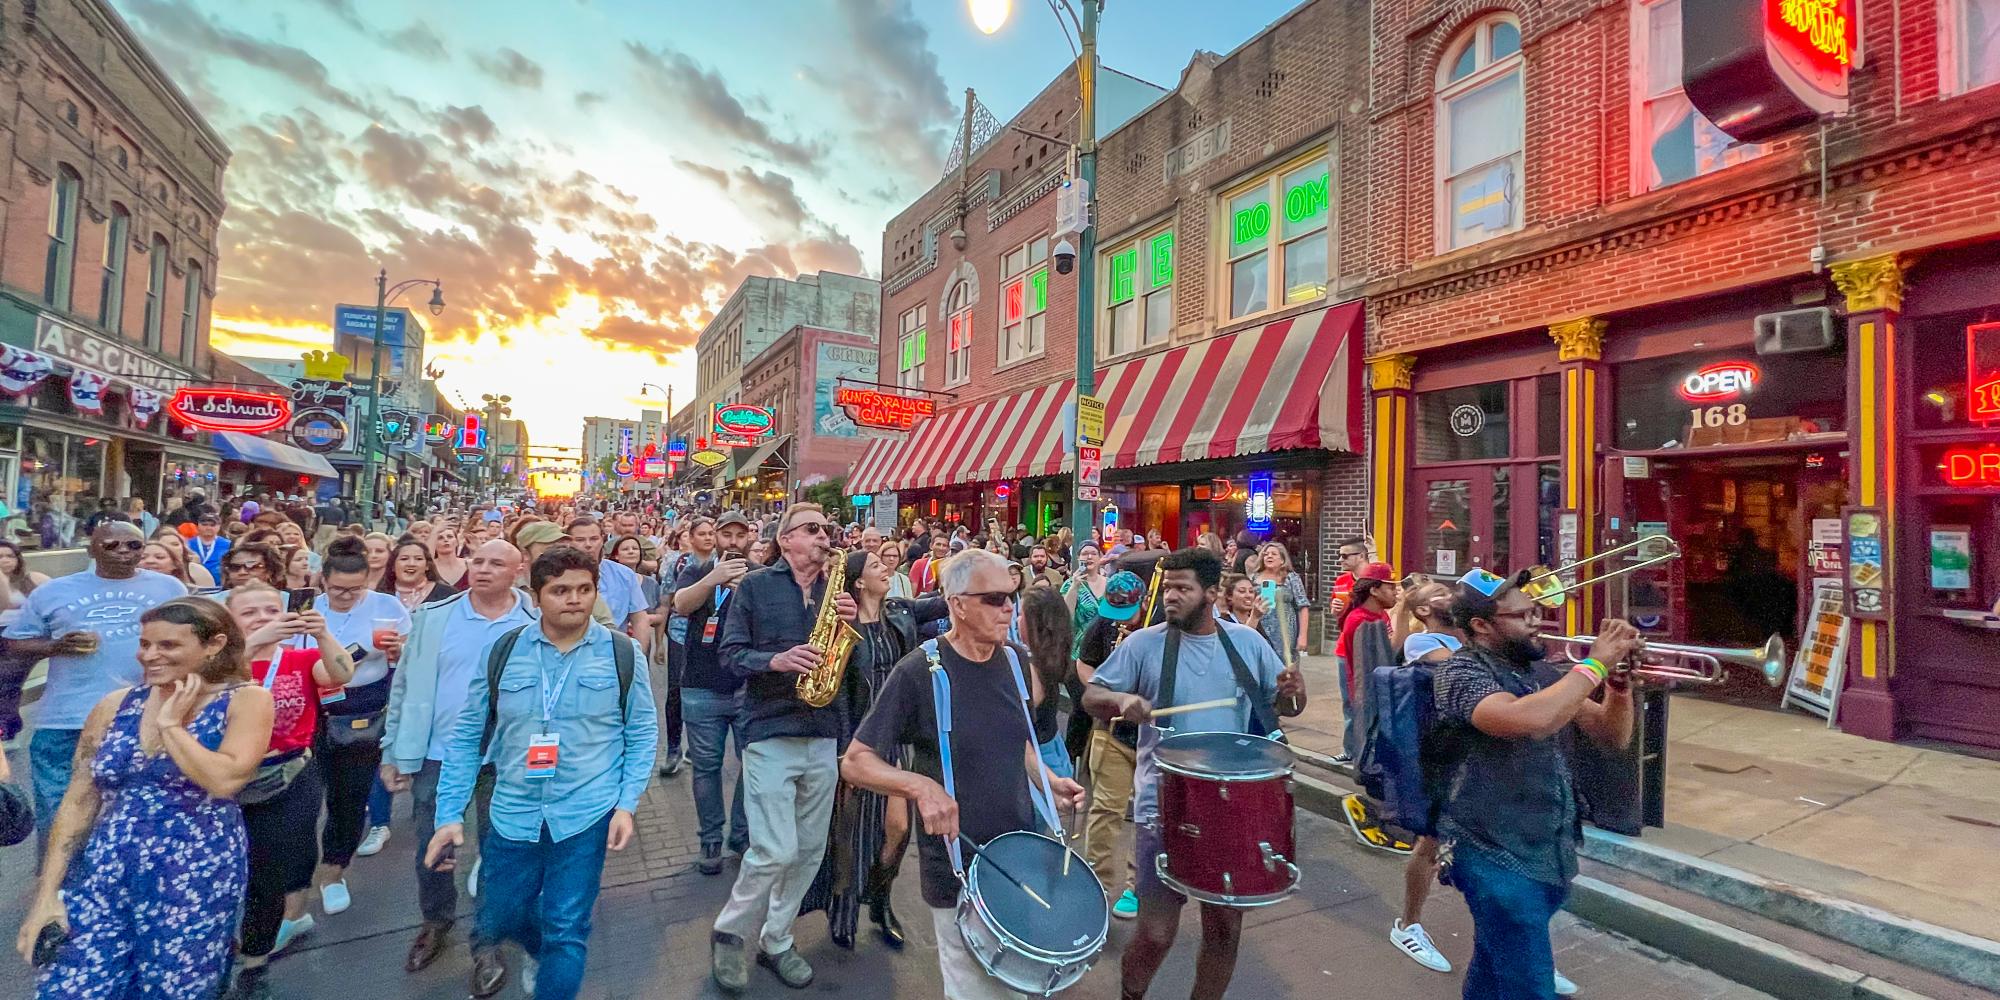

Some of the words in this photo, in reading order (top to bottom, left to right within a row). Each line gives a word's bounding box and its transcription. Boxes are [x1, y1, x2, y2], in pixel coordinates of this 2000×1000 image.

[1685, 370, 1751, 394] OPEN
[176, 395, 200, 411] A.
[203, 395, 281, 418] Schwab
[1081, 397, 1104, 410] NOTICE
[861, 408, 912, 426] CAFE
[1691, 404, 1746, 429] 168
[1083, 449, 1097, 459] NO
